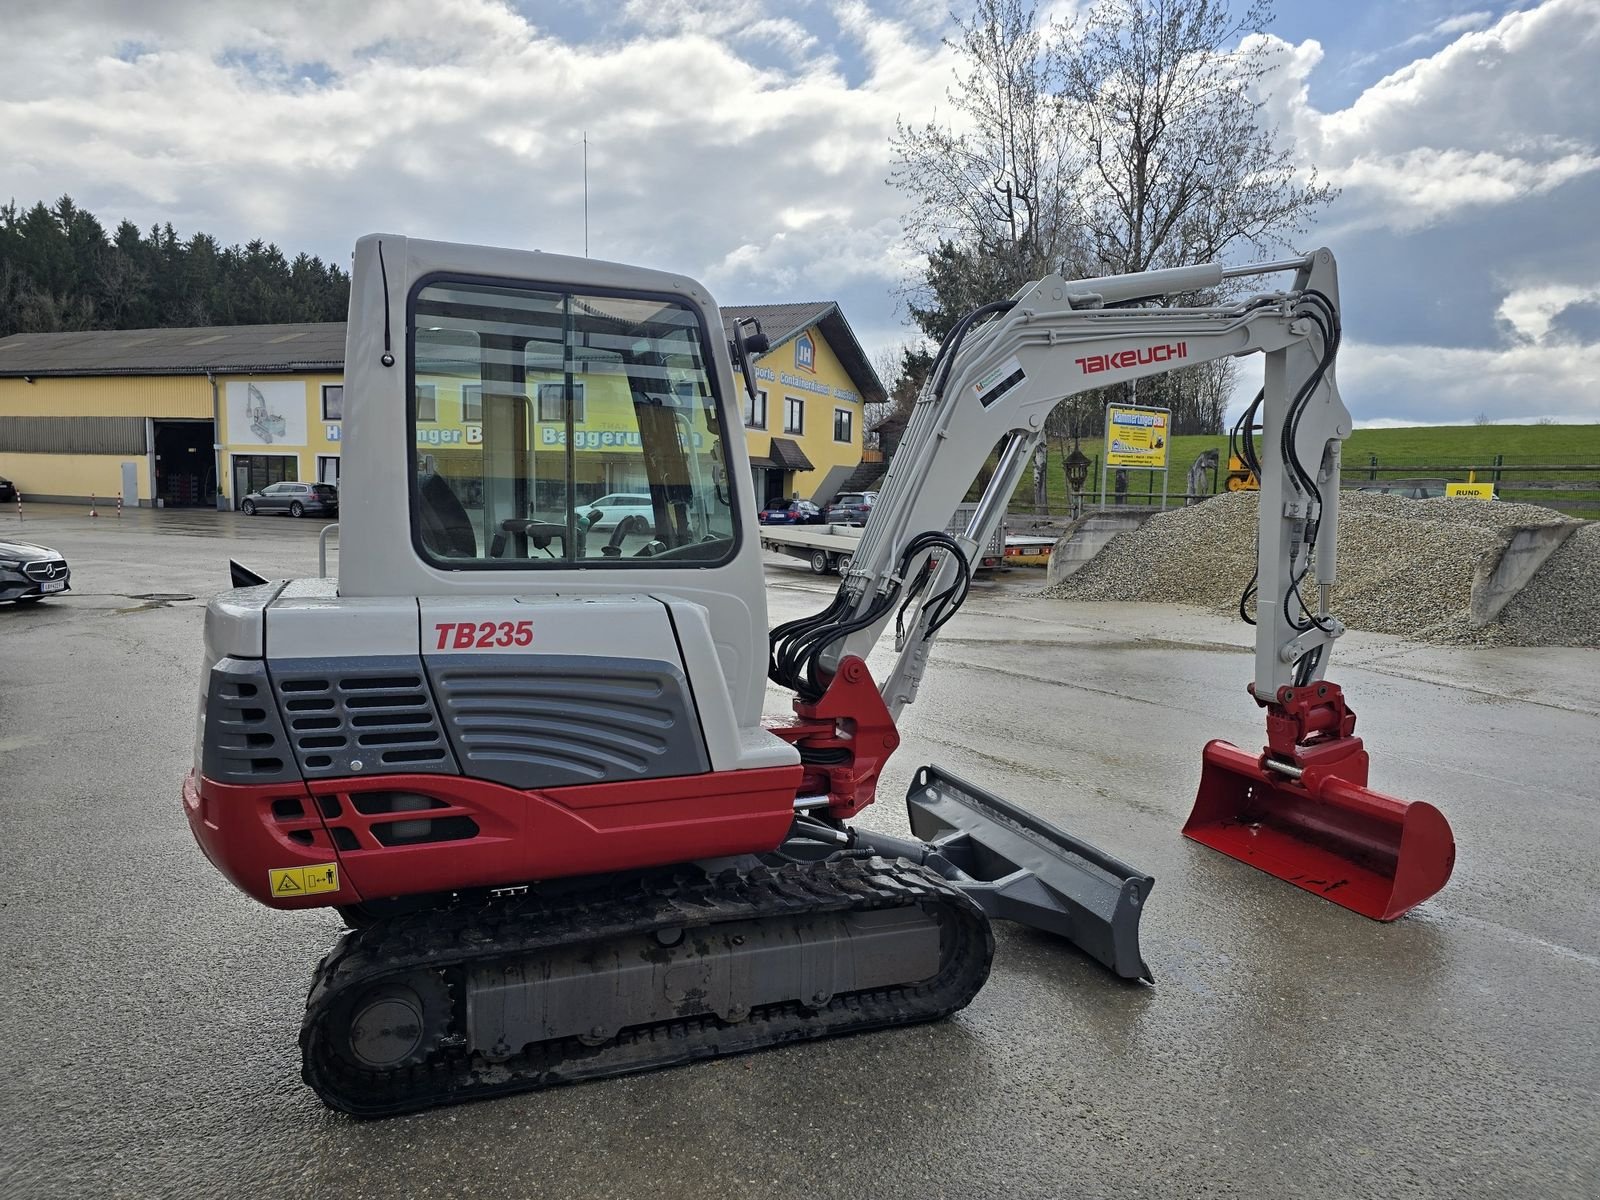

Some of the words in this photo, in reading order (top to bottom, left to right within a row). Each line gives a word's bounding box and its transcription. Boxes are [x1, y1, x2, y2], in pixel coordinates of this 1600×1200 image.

[1075, 341, 1187, 374] TAKEUCHI
[780, 371, 829, 395] Containerdienst
[435, 620, 534, 650] TB235
